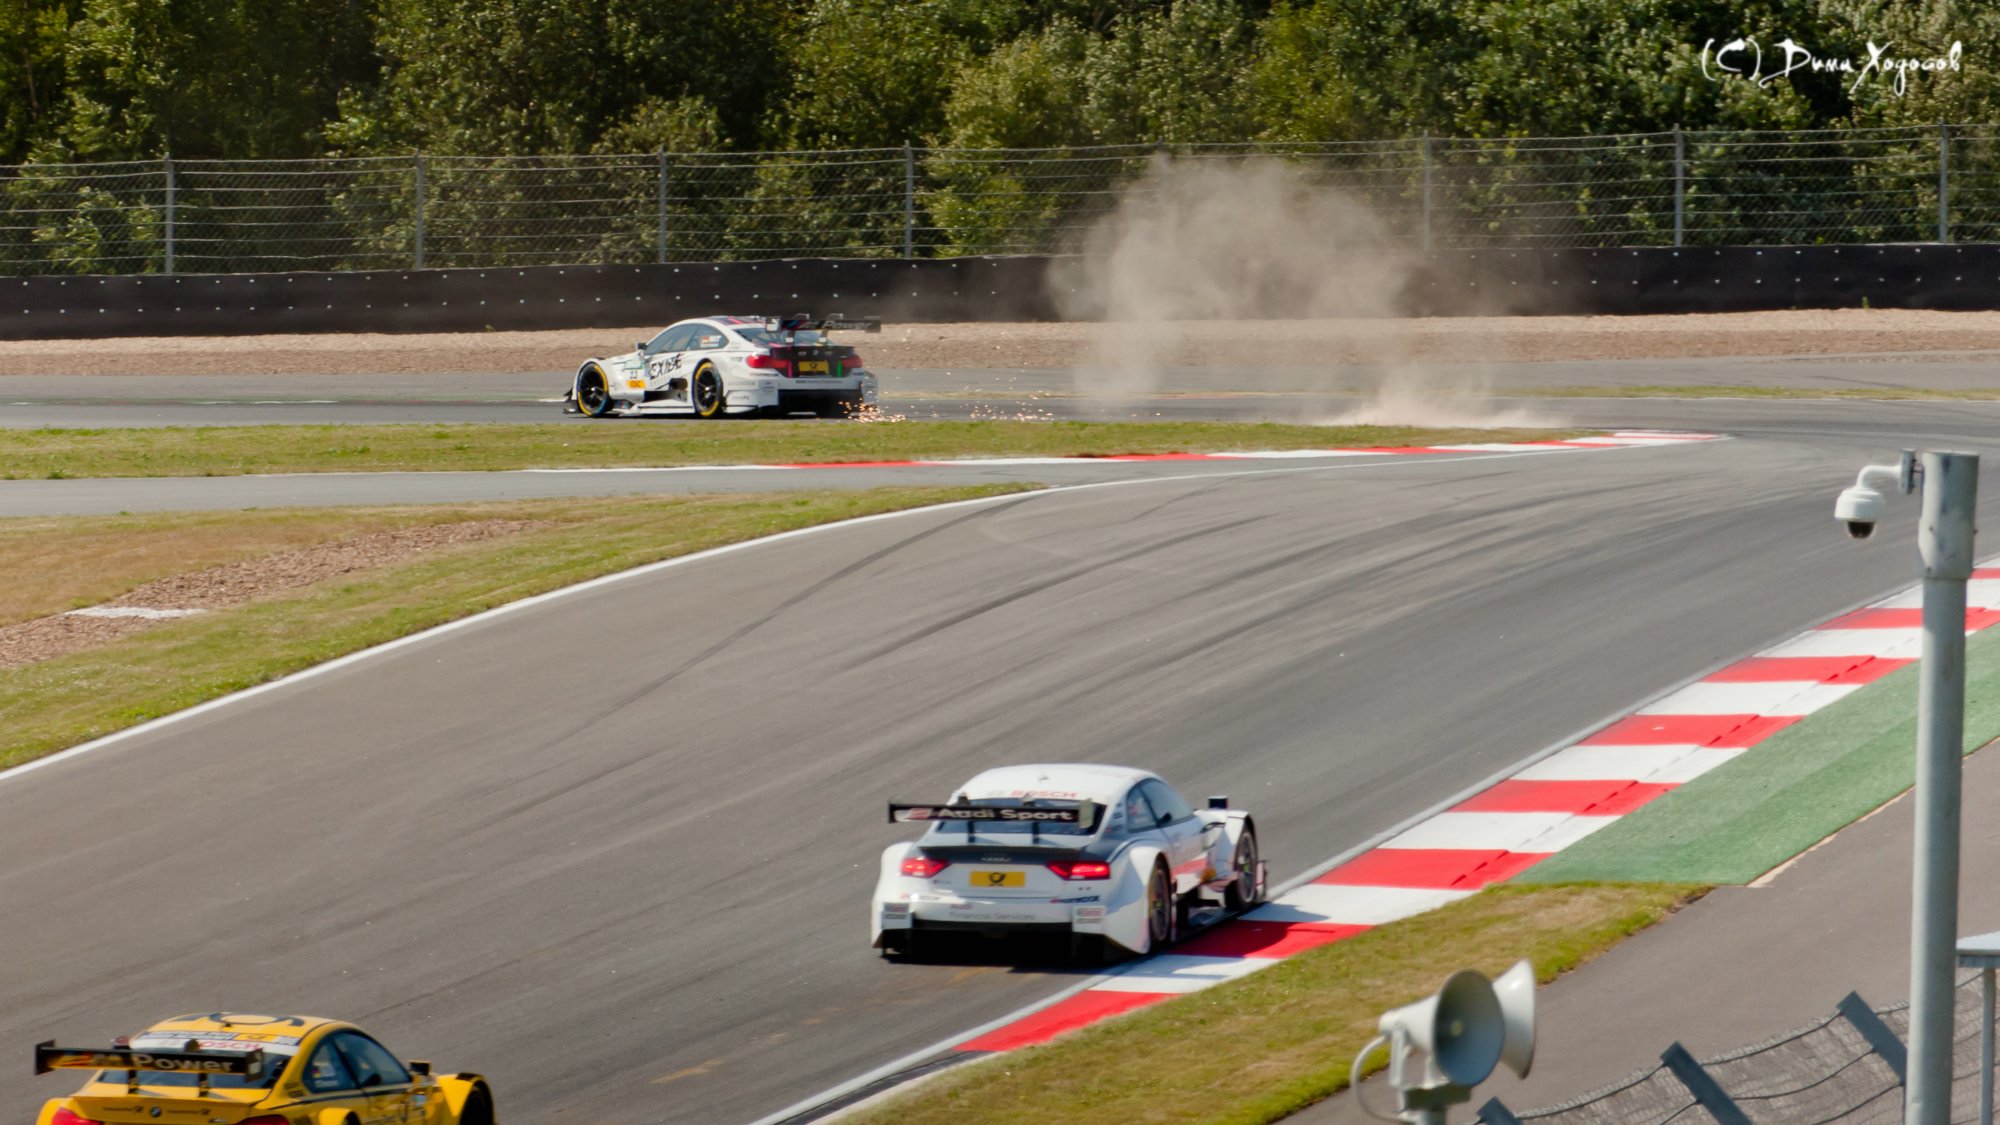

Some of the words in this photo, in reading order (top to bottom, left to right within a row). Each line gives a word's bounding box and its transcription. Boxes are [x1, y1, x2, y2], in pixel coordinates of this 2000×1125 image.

[821, 319, 872, 330] Power
[1010, 789, 1078, 799] BOSCH
[936, 808, 995, 819] Audi
[1002, 808, 1073, 821] Sport
[198, 1040, 260, 1051] OSCH
[132, 1053, 235, 1072] Power
